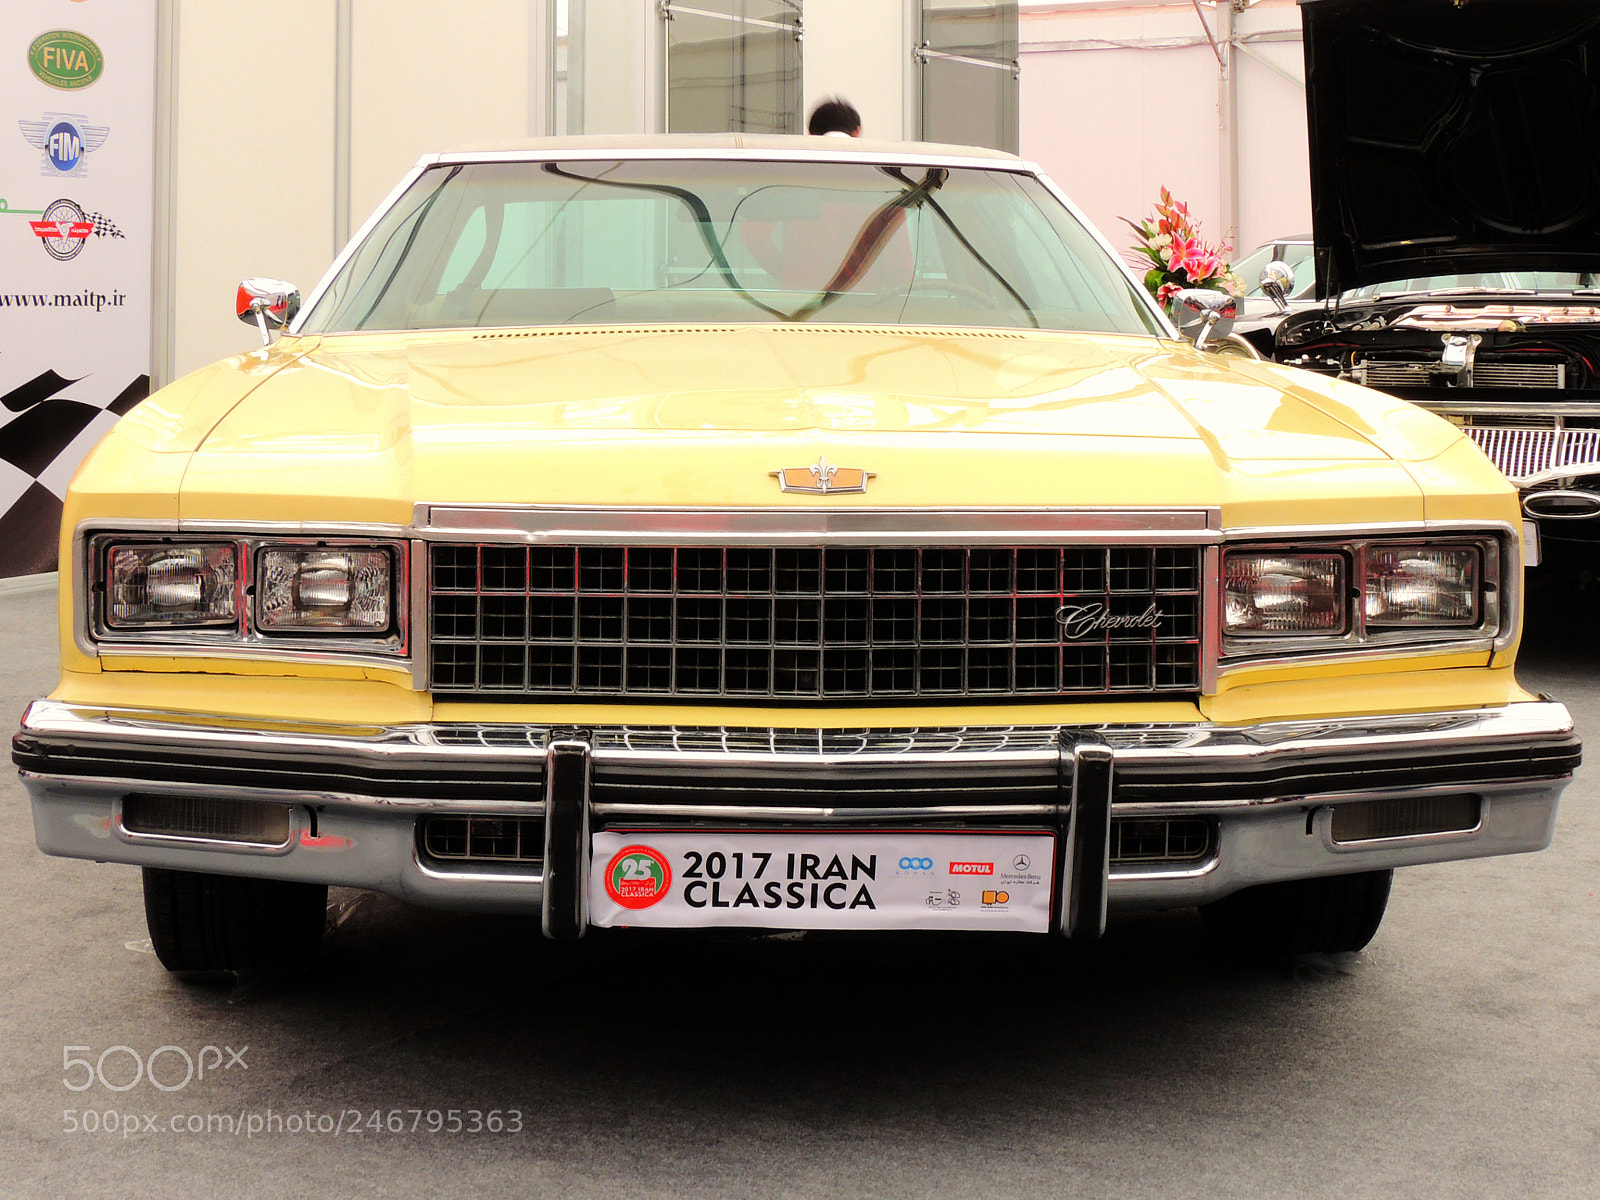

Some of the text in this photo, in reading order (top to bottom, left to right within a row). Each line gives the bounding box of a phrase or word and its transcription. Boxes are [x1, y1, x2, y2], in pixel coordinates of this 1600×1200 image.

[43, 46, 89, 72] FIVA
[49, 131, 80, 161] FIM
[1055, 602, 1164, 639] Chevrolet
[682, 851, 772, 879] 2017
[786, 853, 877, 881] IRAN
[951, 864, 991, 873] MOTUL
[683, 880, 876, 910] CLASSICA
